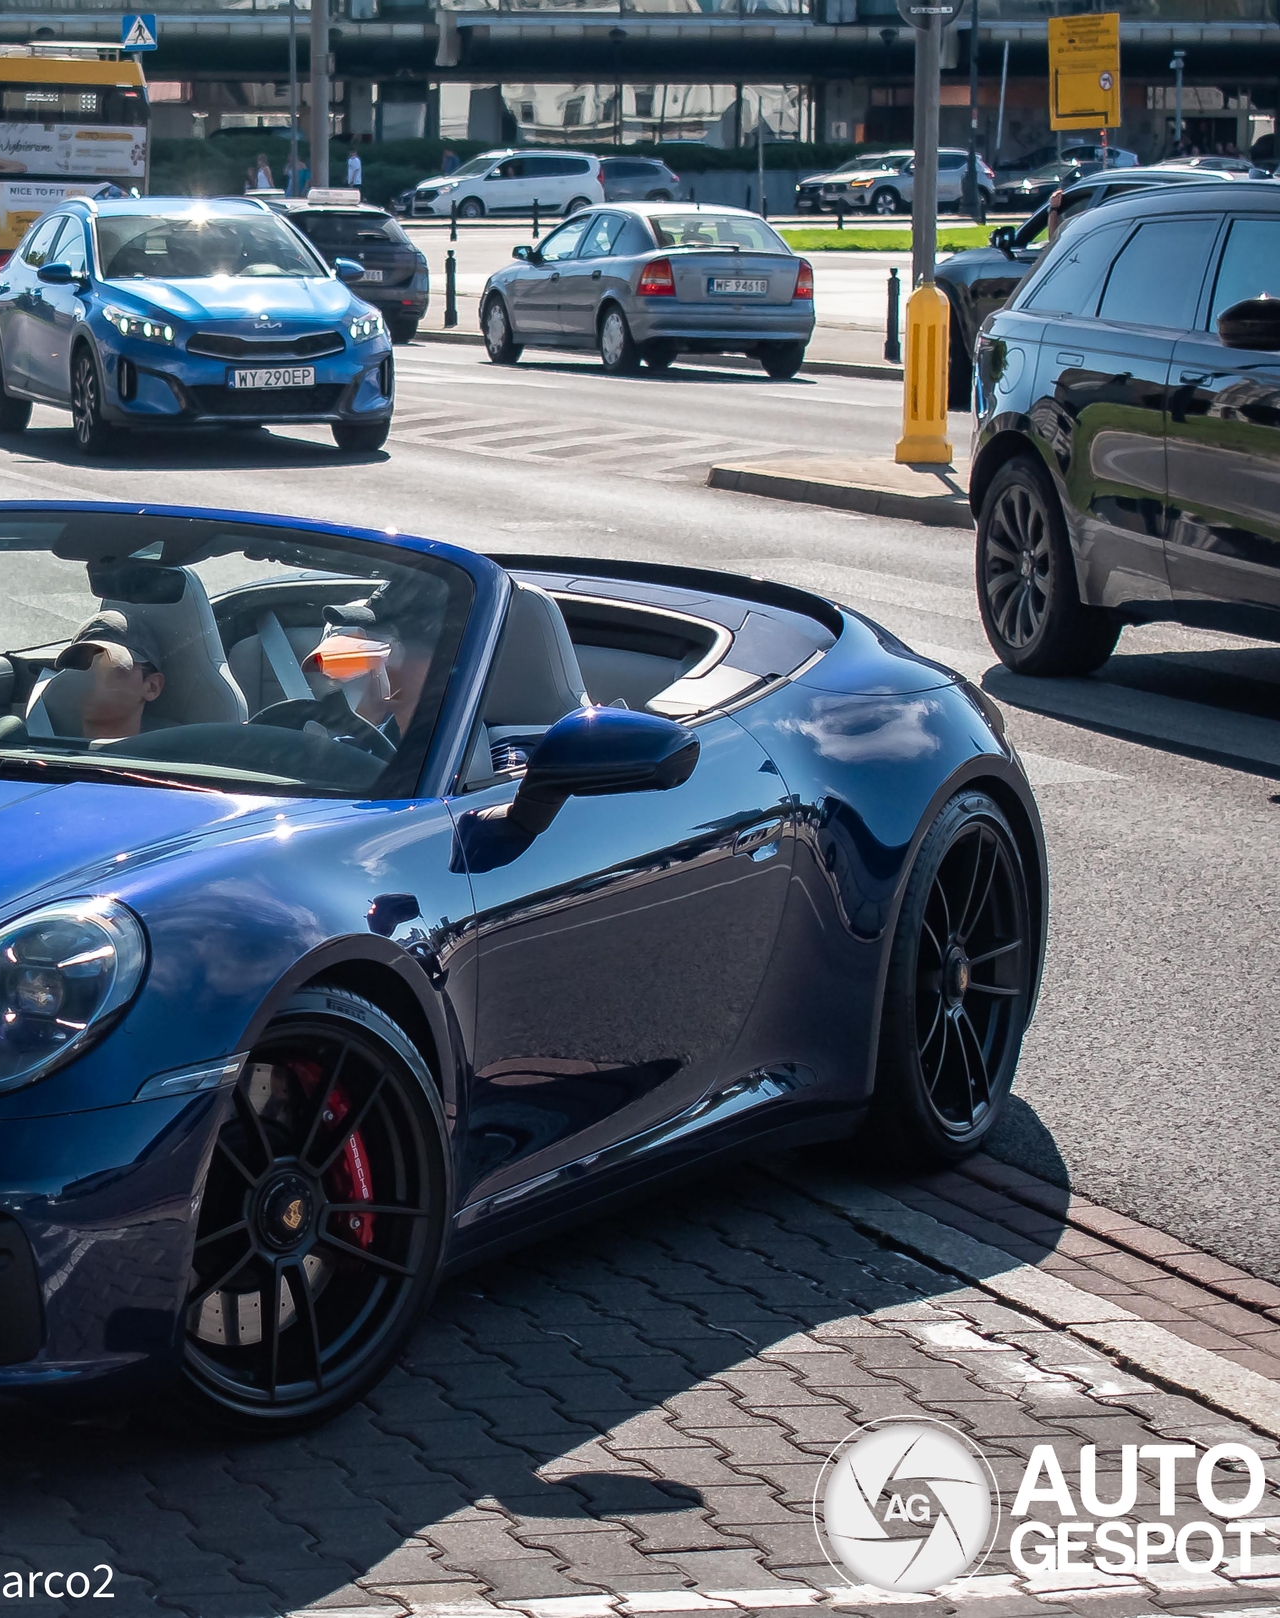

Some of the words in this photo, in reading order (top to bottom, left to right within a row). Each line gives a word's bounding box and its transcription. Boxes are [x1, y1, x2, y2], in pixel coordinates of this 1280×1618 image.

[9, 187, 32, 196] NICE
[35, 188, 48, 196] TO
[49, 188, 66, 197] FIT
[239, 372, 258, 387] WY
[264, 369, 311, 386] 290EP
